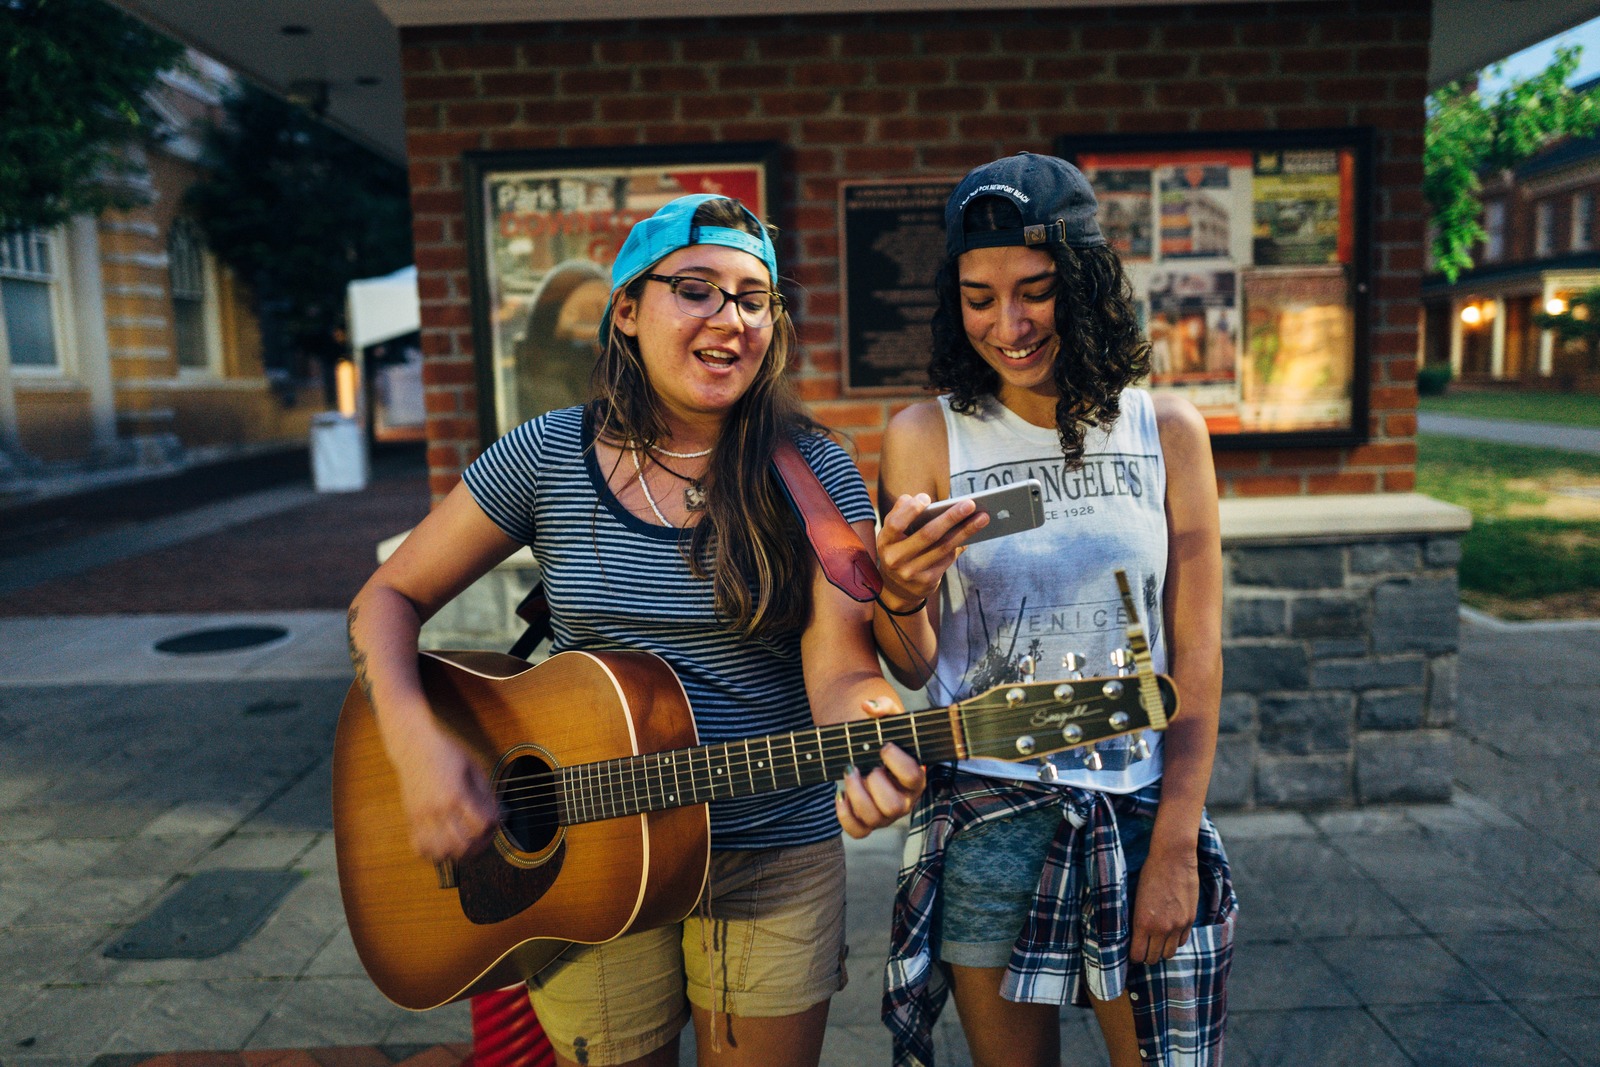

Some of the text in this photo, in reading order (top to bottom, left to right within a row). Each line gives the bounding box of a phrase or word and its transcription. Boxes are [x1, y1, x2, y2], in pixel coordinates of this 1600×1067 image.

[990, 184, 1014, 193] NEWPORT
[1013, 189, 1030, 203] BEACH
[1064, 506, 1095, 518] 1928
[1002, 609, 1129, 633] VENICE
